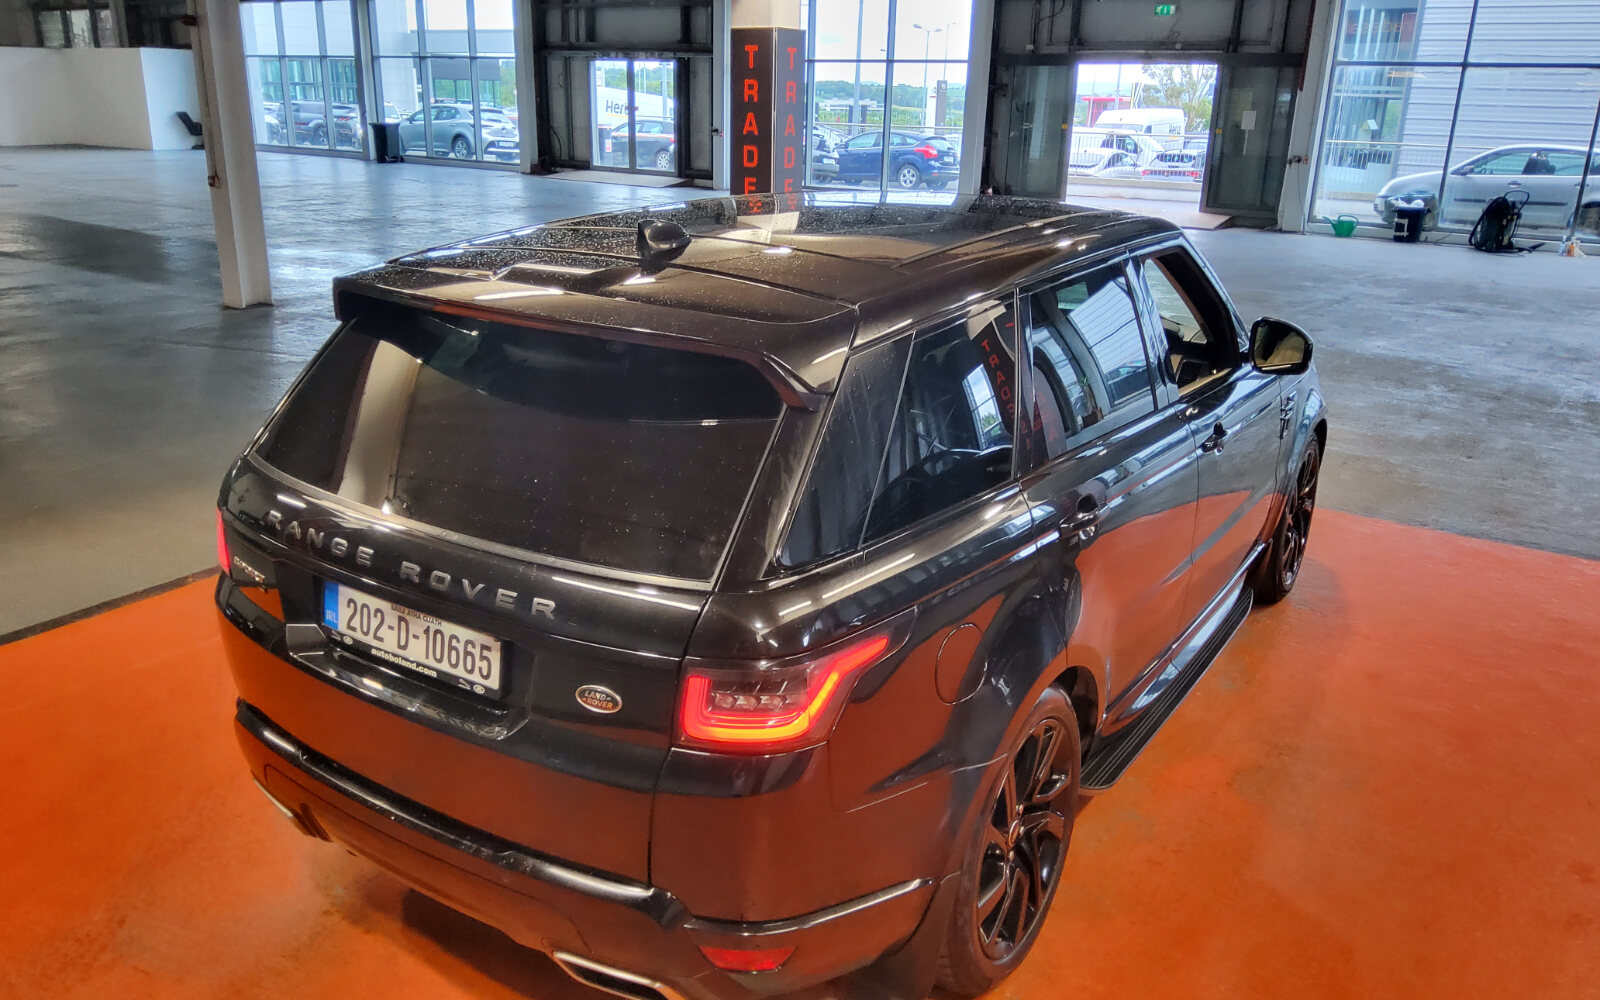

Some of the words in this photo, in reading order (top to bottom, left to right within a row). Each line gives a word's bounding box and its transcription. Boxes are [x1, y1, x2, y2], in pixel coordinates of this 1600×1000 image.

[264, 510, 374, 568] RANGE
[400, 560, 556, 620] ROVER
[346, 597, 493, 681] 202-D-10665
[371, 648, 438, 678] autoboland.com
[584, 690, 607, 701] LAND
[586, 697, 613, 709] ROVER
